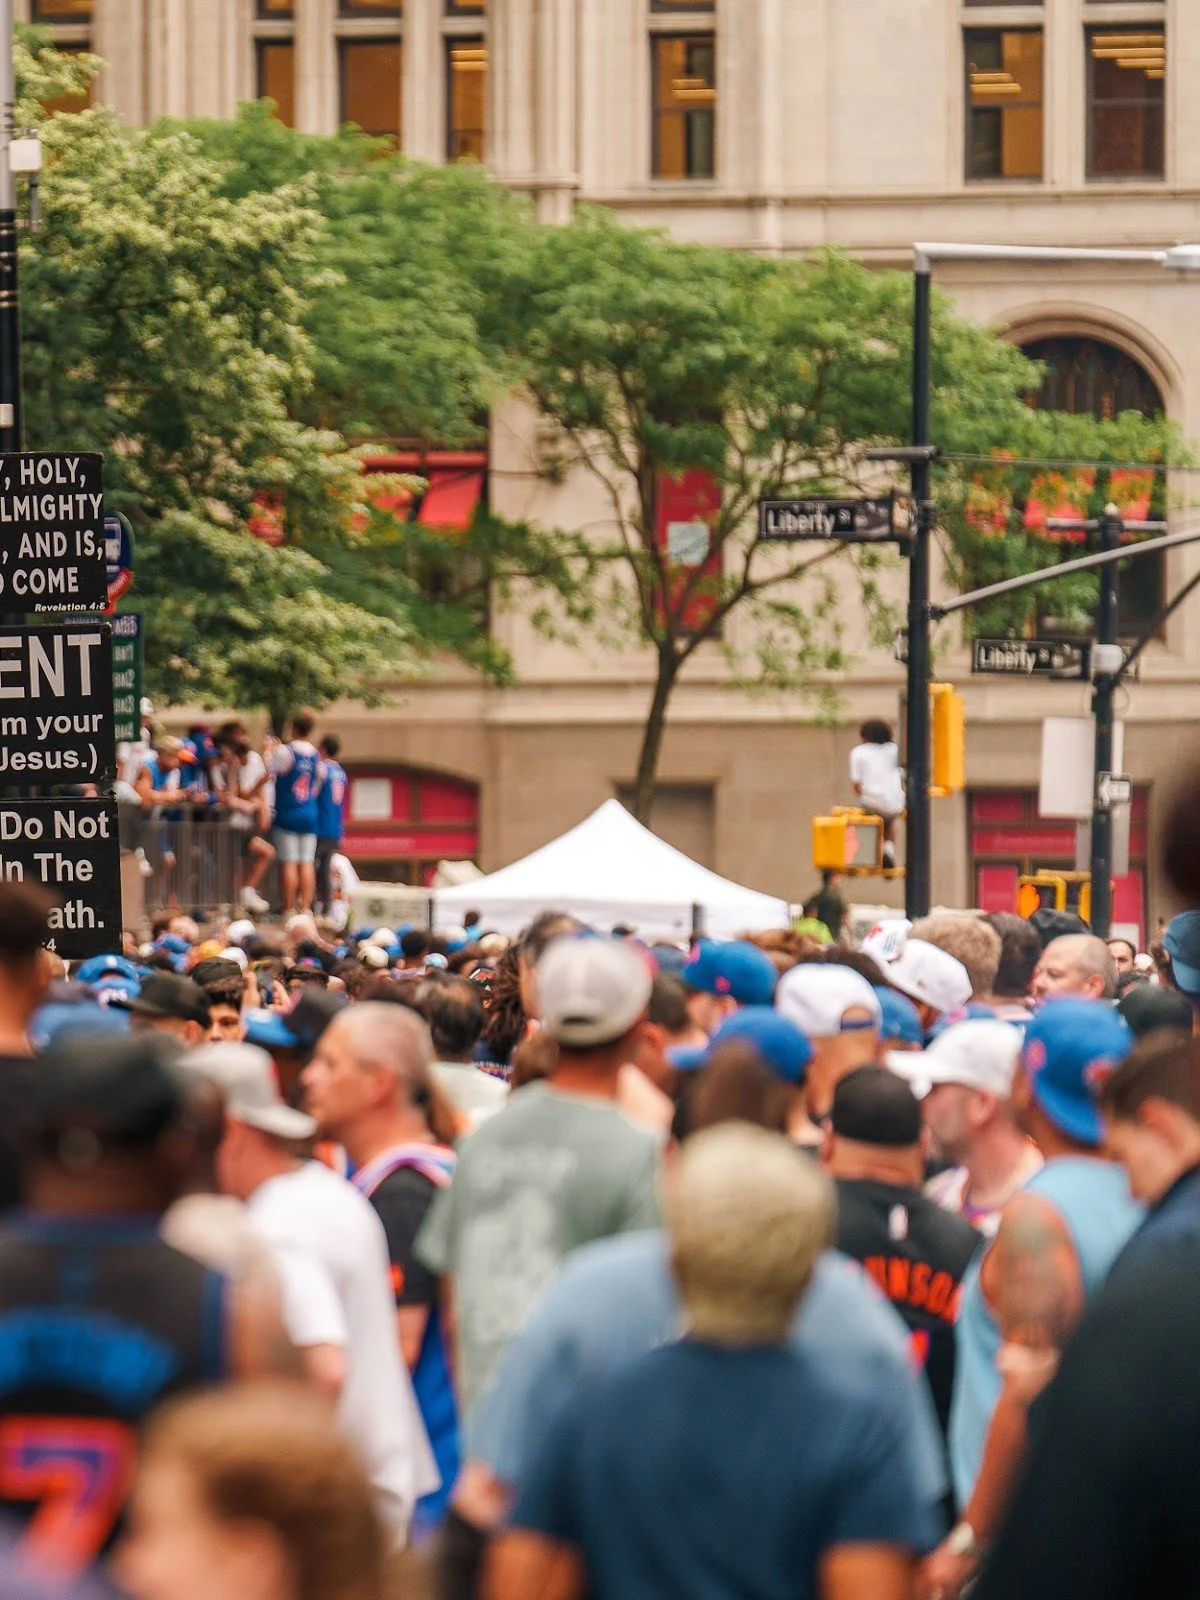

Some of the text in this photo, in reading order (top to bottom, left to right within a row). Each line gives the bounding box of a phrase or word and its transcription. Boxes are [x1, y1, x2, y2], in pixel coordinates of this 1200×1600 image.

[20, 457, 86, 488] HOLY,
[767, 508, 836, 537] Liberty
[18, 530, 67, 559] AND
[75, 529, 104, 561] IS,
[12, 566, 79, 595] COME
[34, 602, 87, 613] Revelation
[978, 646, 1036, 674] Liberty
[36, 713, 104, 741] your
[0, 811, 44, 840] Do
[53, 809, 110, 839] Not
[33, 852, 94, 882] The
[47, 900, 105, 930] ath.
